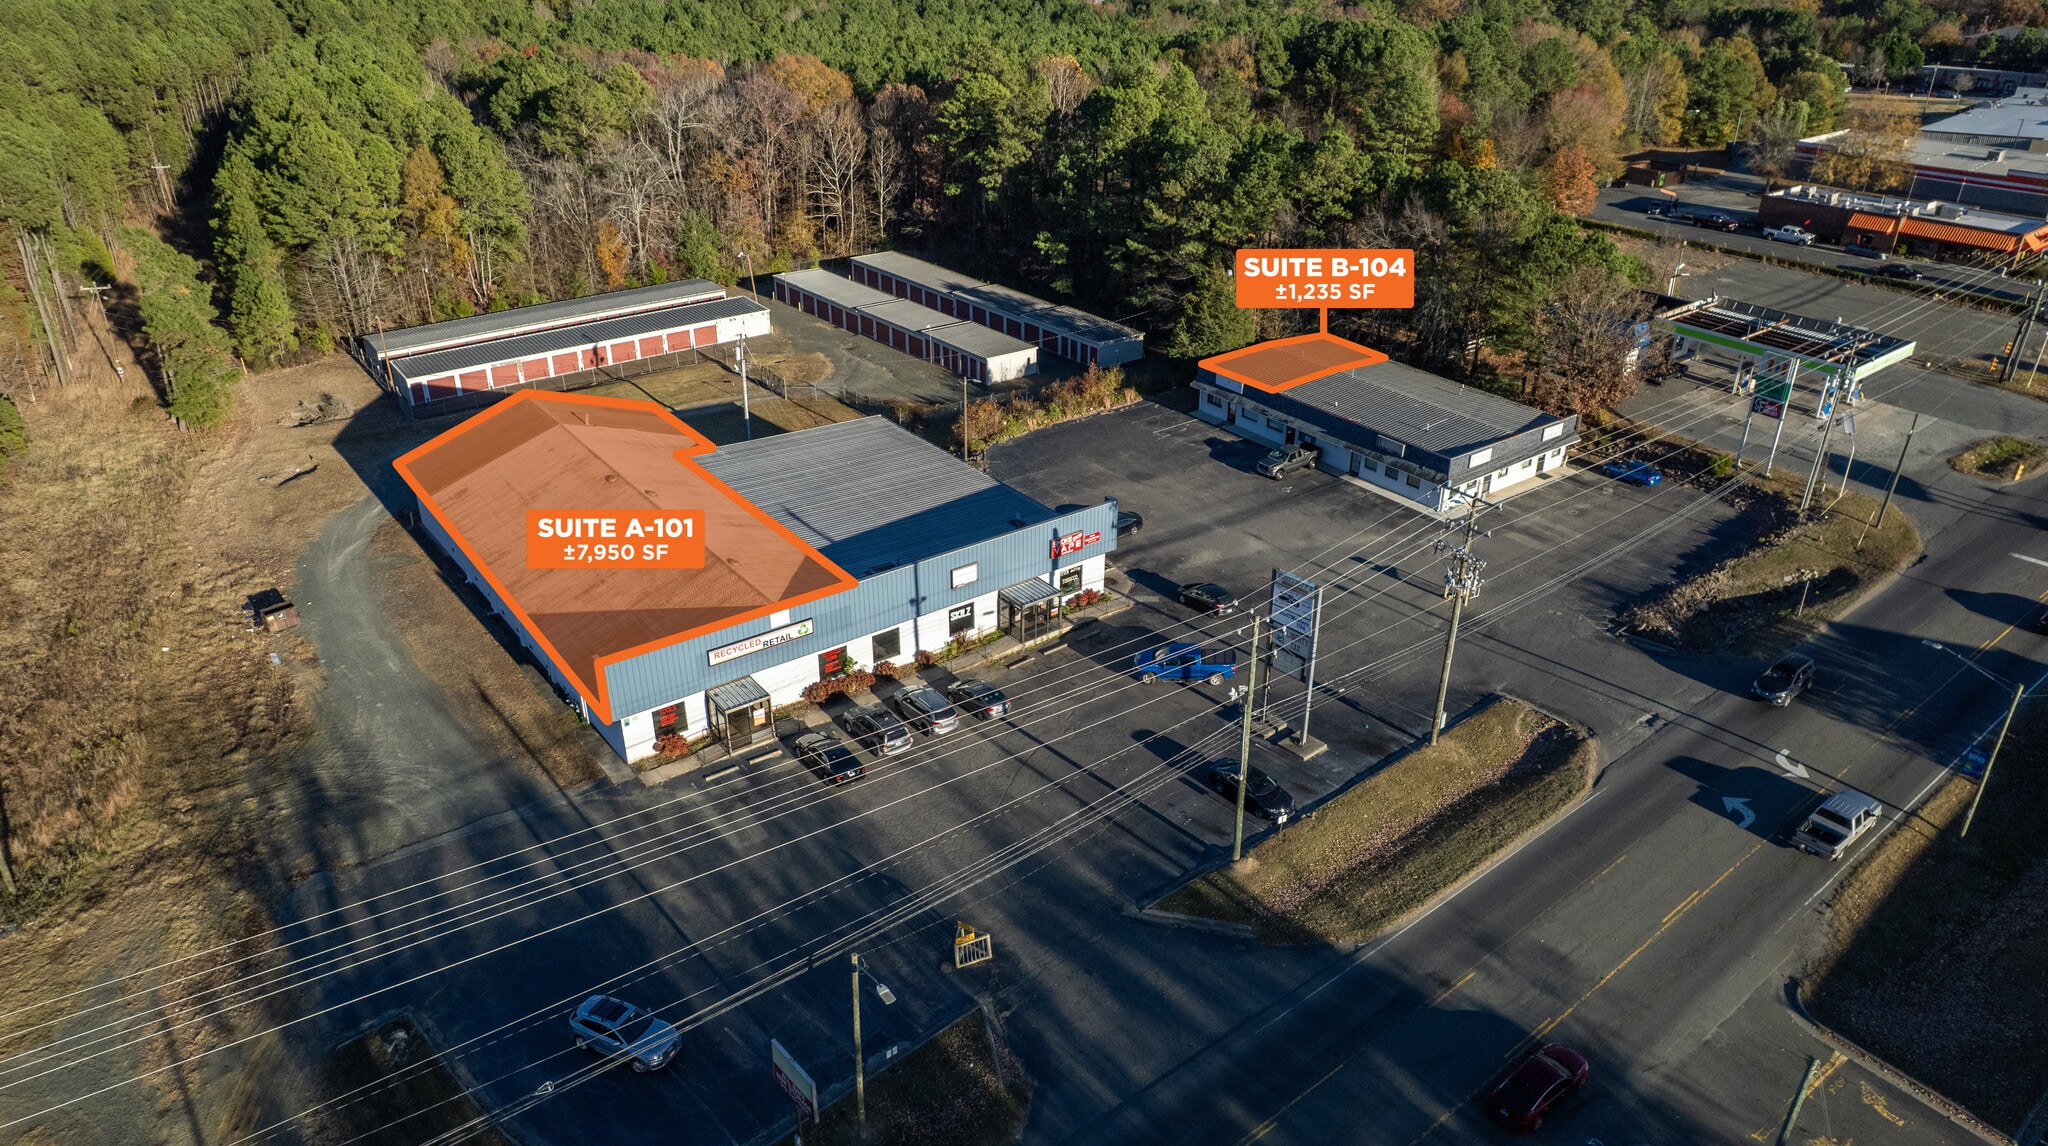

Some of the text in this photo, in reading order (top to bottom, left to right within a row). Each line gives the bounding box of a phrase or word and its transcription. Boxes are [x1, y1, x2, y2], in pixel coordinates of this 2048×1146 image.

[1053, 540, 1082, 555] VAPE
[714, 633, 794, 660] RECYCLED RETAIL
